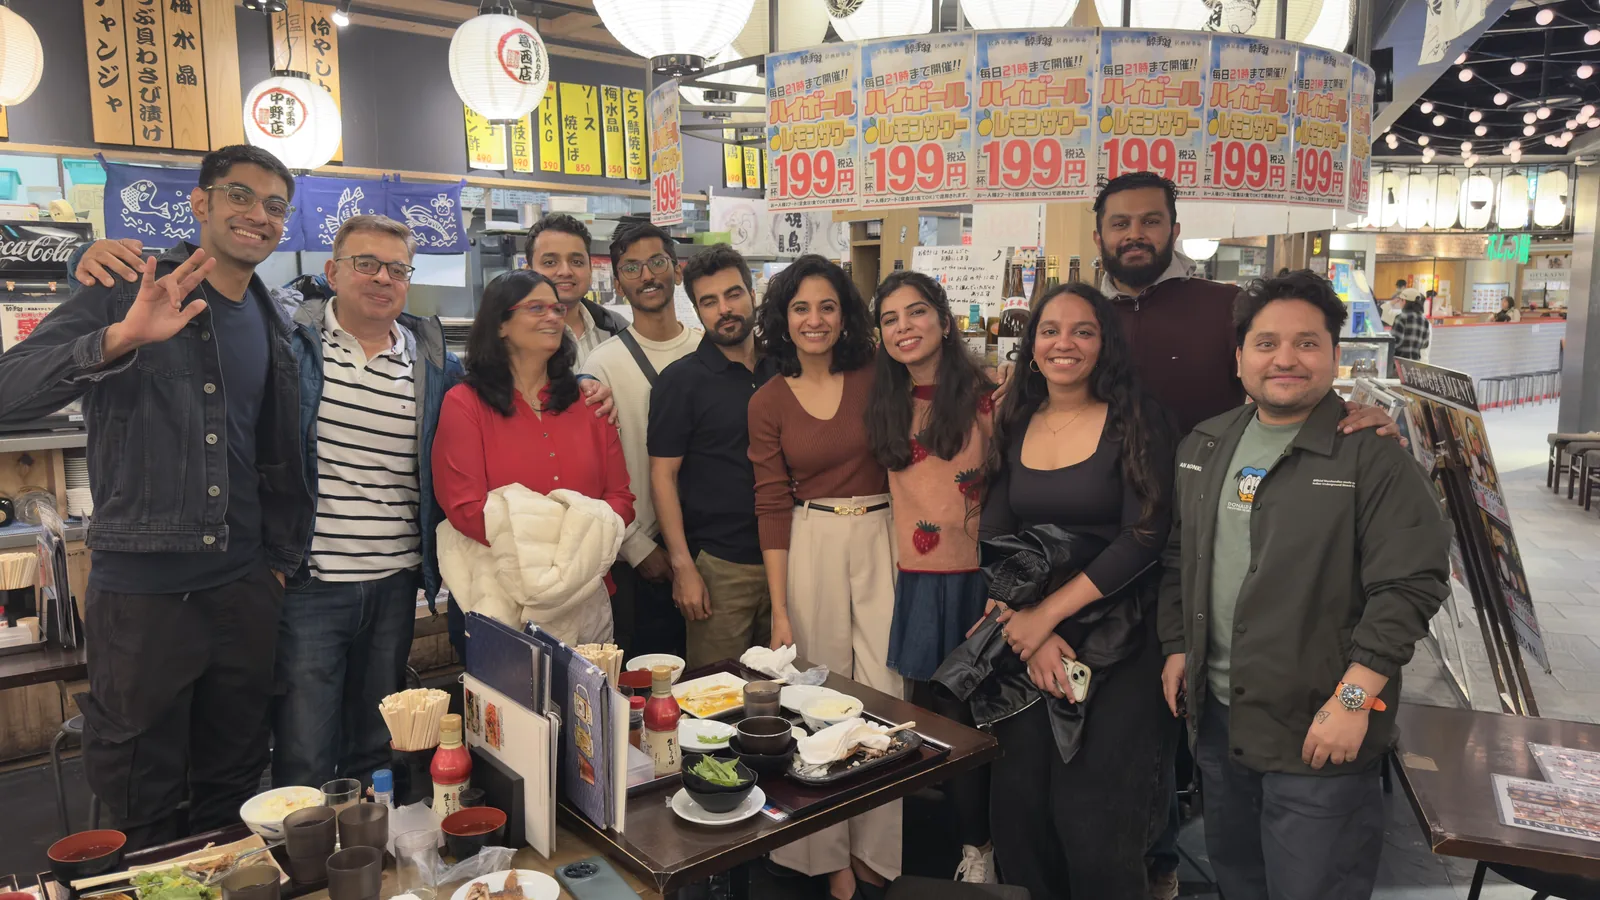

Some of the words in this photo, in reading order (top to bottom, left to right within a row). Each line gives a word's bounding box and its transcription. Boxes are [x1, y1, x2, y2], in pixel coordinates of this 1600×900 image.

[95, 0, 123, 113] ャンジャ
[865, 81, 968, 116] ハイボール
[979, 75, 1089, 107] ハイボール
[1101, 76, 1202, 106] ハイボール
[1210, 82, 1288, 113] ハイボール
[269, 92, 284, 134] 中野店
[543, 96, 553, 142] TKG
[582, 85, 596, 131] ソース
[605, 87, 619, 132] 梅水晶
[770, 90, 855, 124] ハイボール
[627, 90, 641, 166] とろ鯖焼き
[781, 122, 855, 151] レモンサワー
[878, 114, 968, 144] レモンサワー
[993, 110, 1088, 137] レモンサワー
[1114, 110, 1200, 136] レモンサワー
[1219, 113, 1286, 141] レモンサワー
[564, 115, 579, 161] 焼そば
[543, 161, 558, 170] 390
[576, 164, 591, 172] 850
[838, 158, 853, 167] 税込
[870, 143, 944, 192] 199
[947, 151, 966, 162] 税込
[983, 138, 1061, 187] 199
[1065, 148, 1085, 159] 税込
[1104, 138, 1176, 181] 199
[1179, 149, 1197, 160] 税込
[1211, 141, 1268, 187] 199
[1270, 154, 1285, 164] 税込
[608, 165, 622, 174] 550
[775, 150, 835, 196] 199
[838, 169, 854, 192] 円
[946, 163, 966, 186] 円
[1064, 160, 1086, 184] 円
[1178, 161, 1197, 184] 円
[1270, 166, 1285, 187] 円
[1296, 148, 1332, 193] 199
[1332, 172, 1344, 193] 円
[655, 172, 677, 212] 199
[0, 235, 78, 262] oca-Cola
[443, 793, 451, 816] 生しょう
